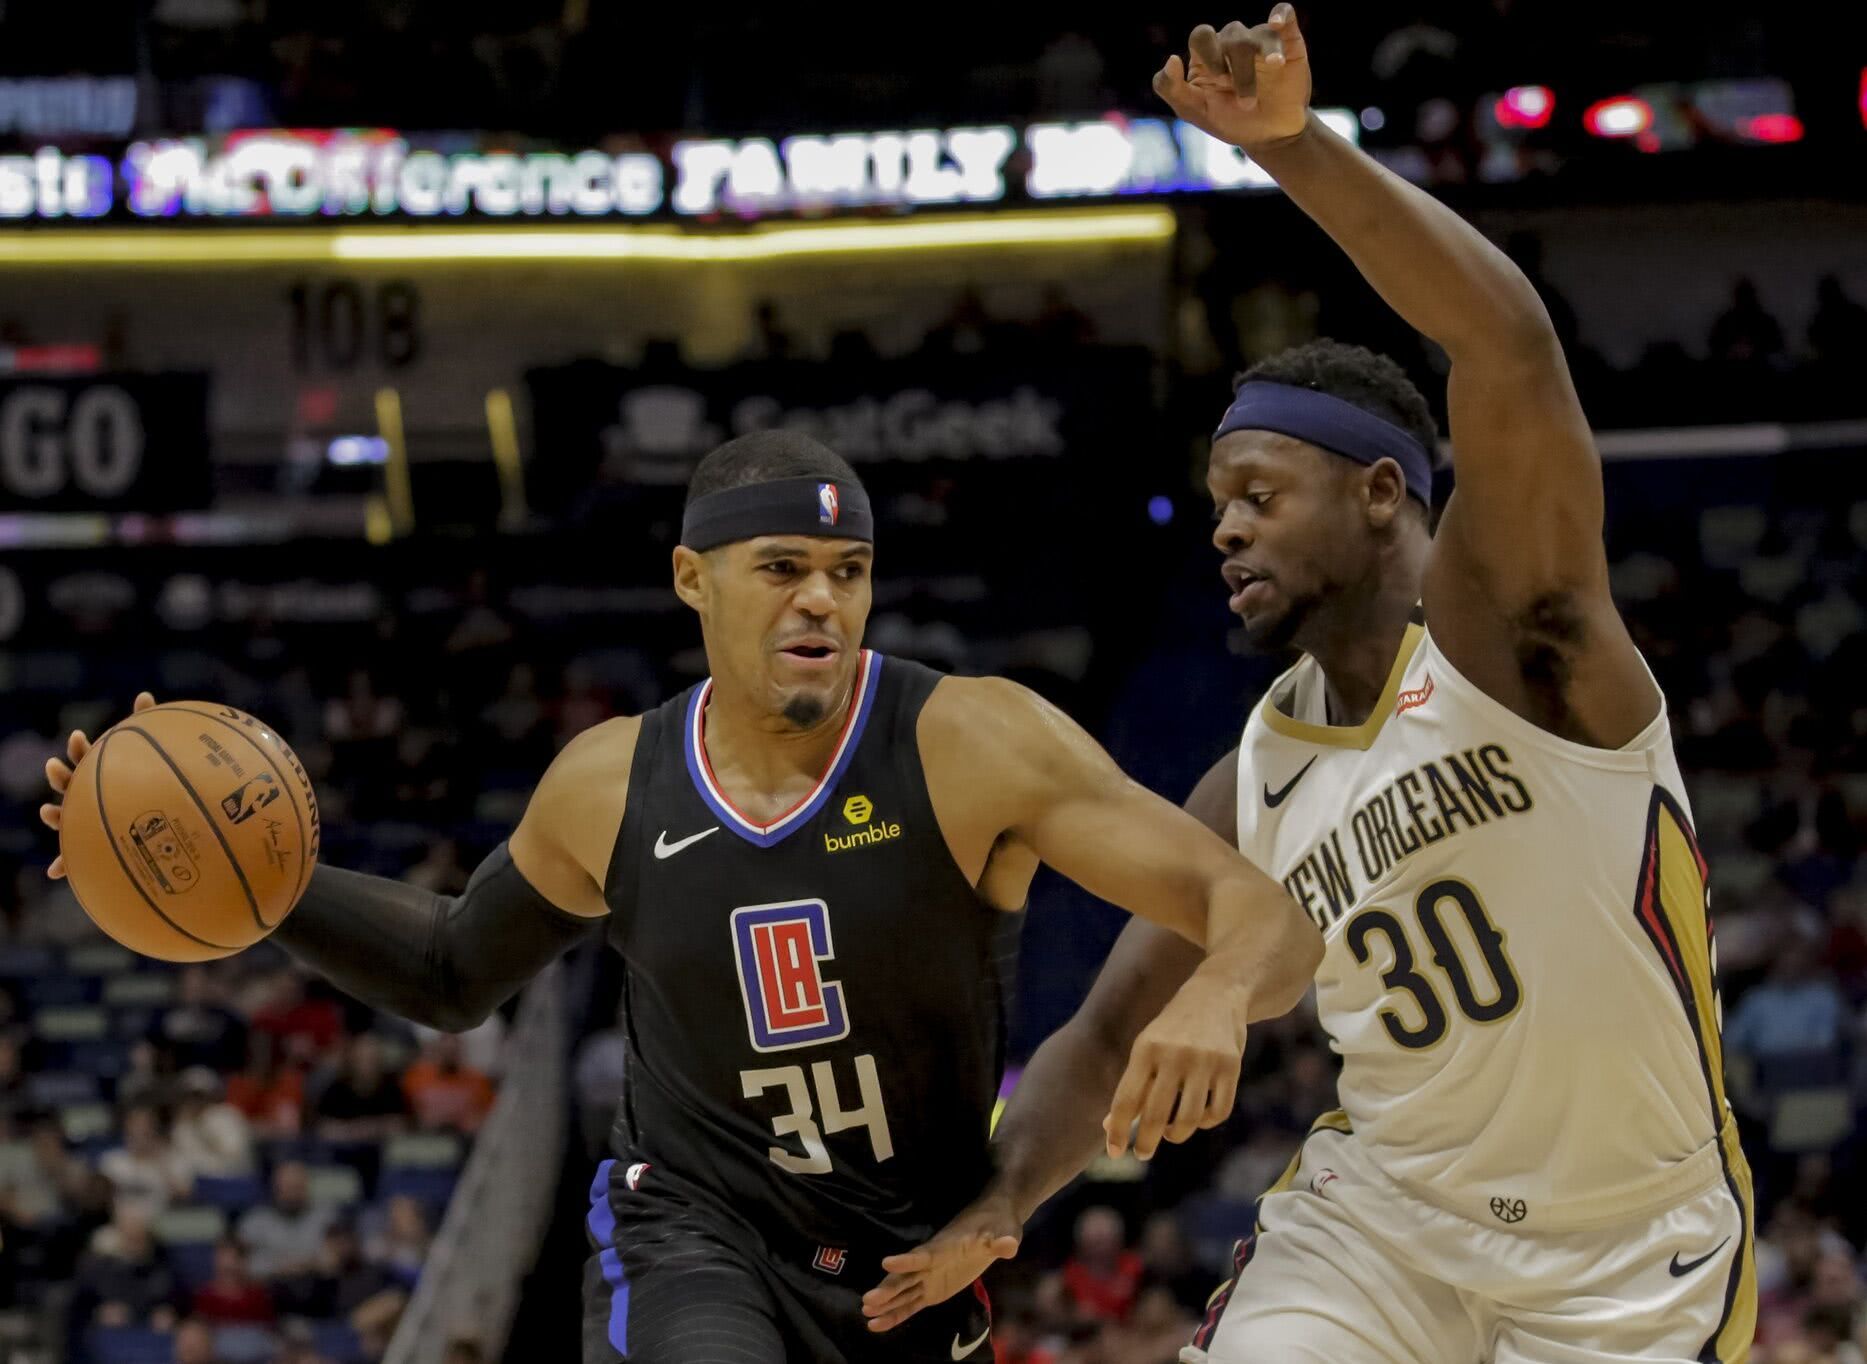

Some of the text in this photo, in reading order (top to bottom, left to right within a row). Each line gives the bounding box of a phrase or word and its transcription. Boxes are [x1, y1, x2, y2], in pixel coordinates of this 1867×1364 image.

[673, 127, 1011, 213] FAMILY
[289, 277, 420, 371] 108
[220, 707, 319, 857] SLDING
[824, 820, 901, 853] bumble
[1351, 741, 1535, 884] ORLEANS
[1344, 874, 1526, 1052] 30
[739, 1053, 895, 1175] 34
